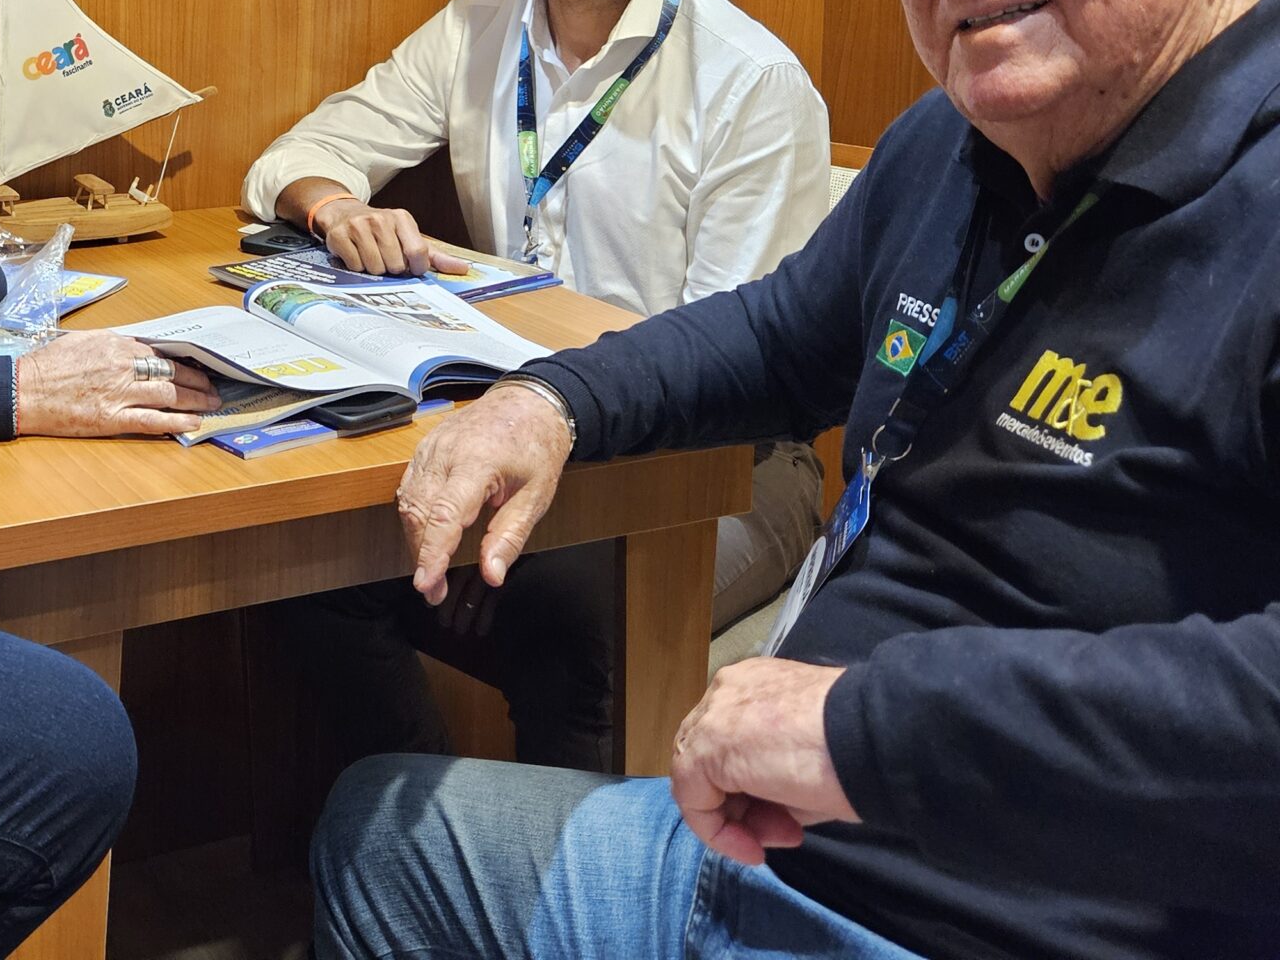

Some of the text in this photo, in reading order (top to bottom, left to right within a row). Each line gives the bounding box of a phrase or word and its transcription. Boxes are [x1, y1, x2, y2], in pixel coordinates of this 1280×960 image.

[22, 33, 90, 81] ceará
[62, 59, 94, 78] fascinante
[114, 82, 153, 106] CEARÁ
[897, 292, 941, 328] PRESS
